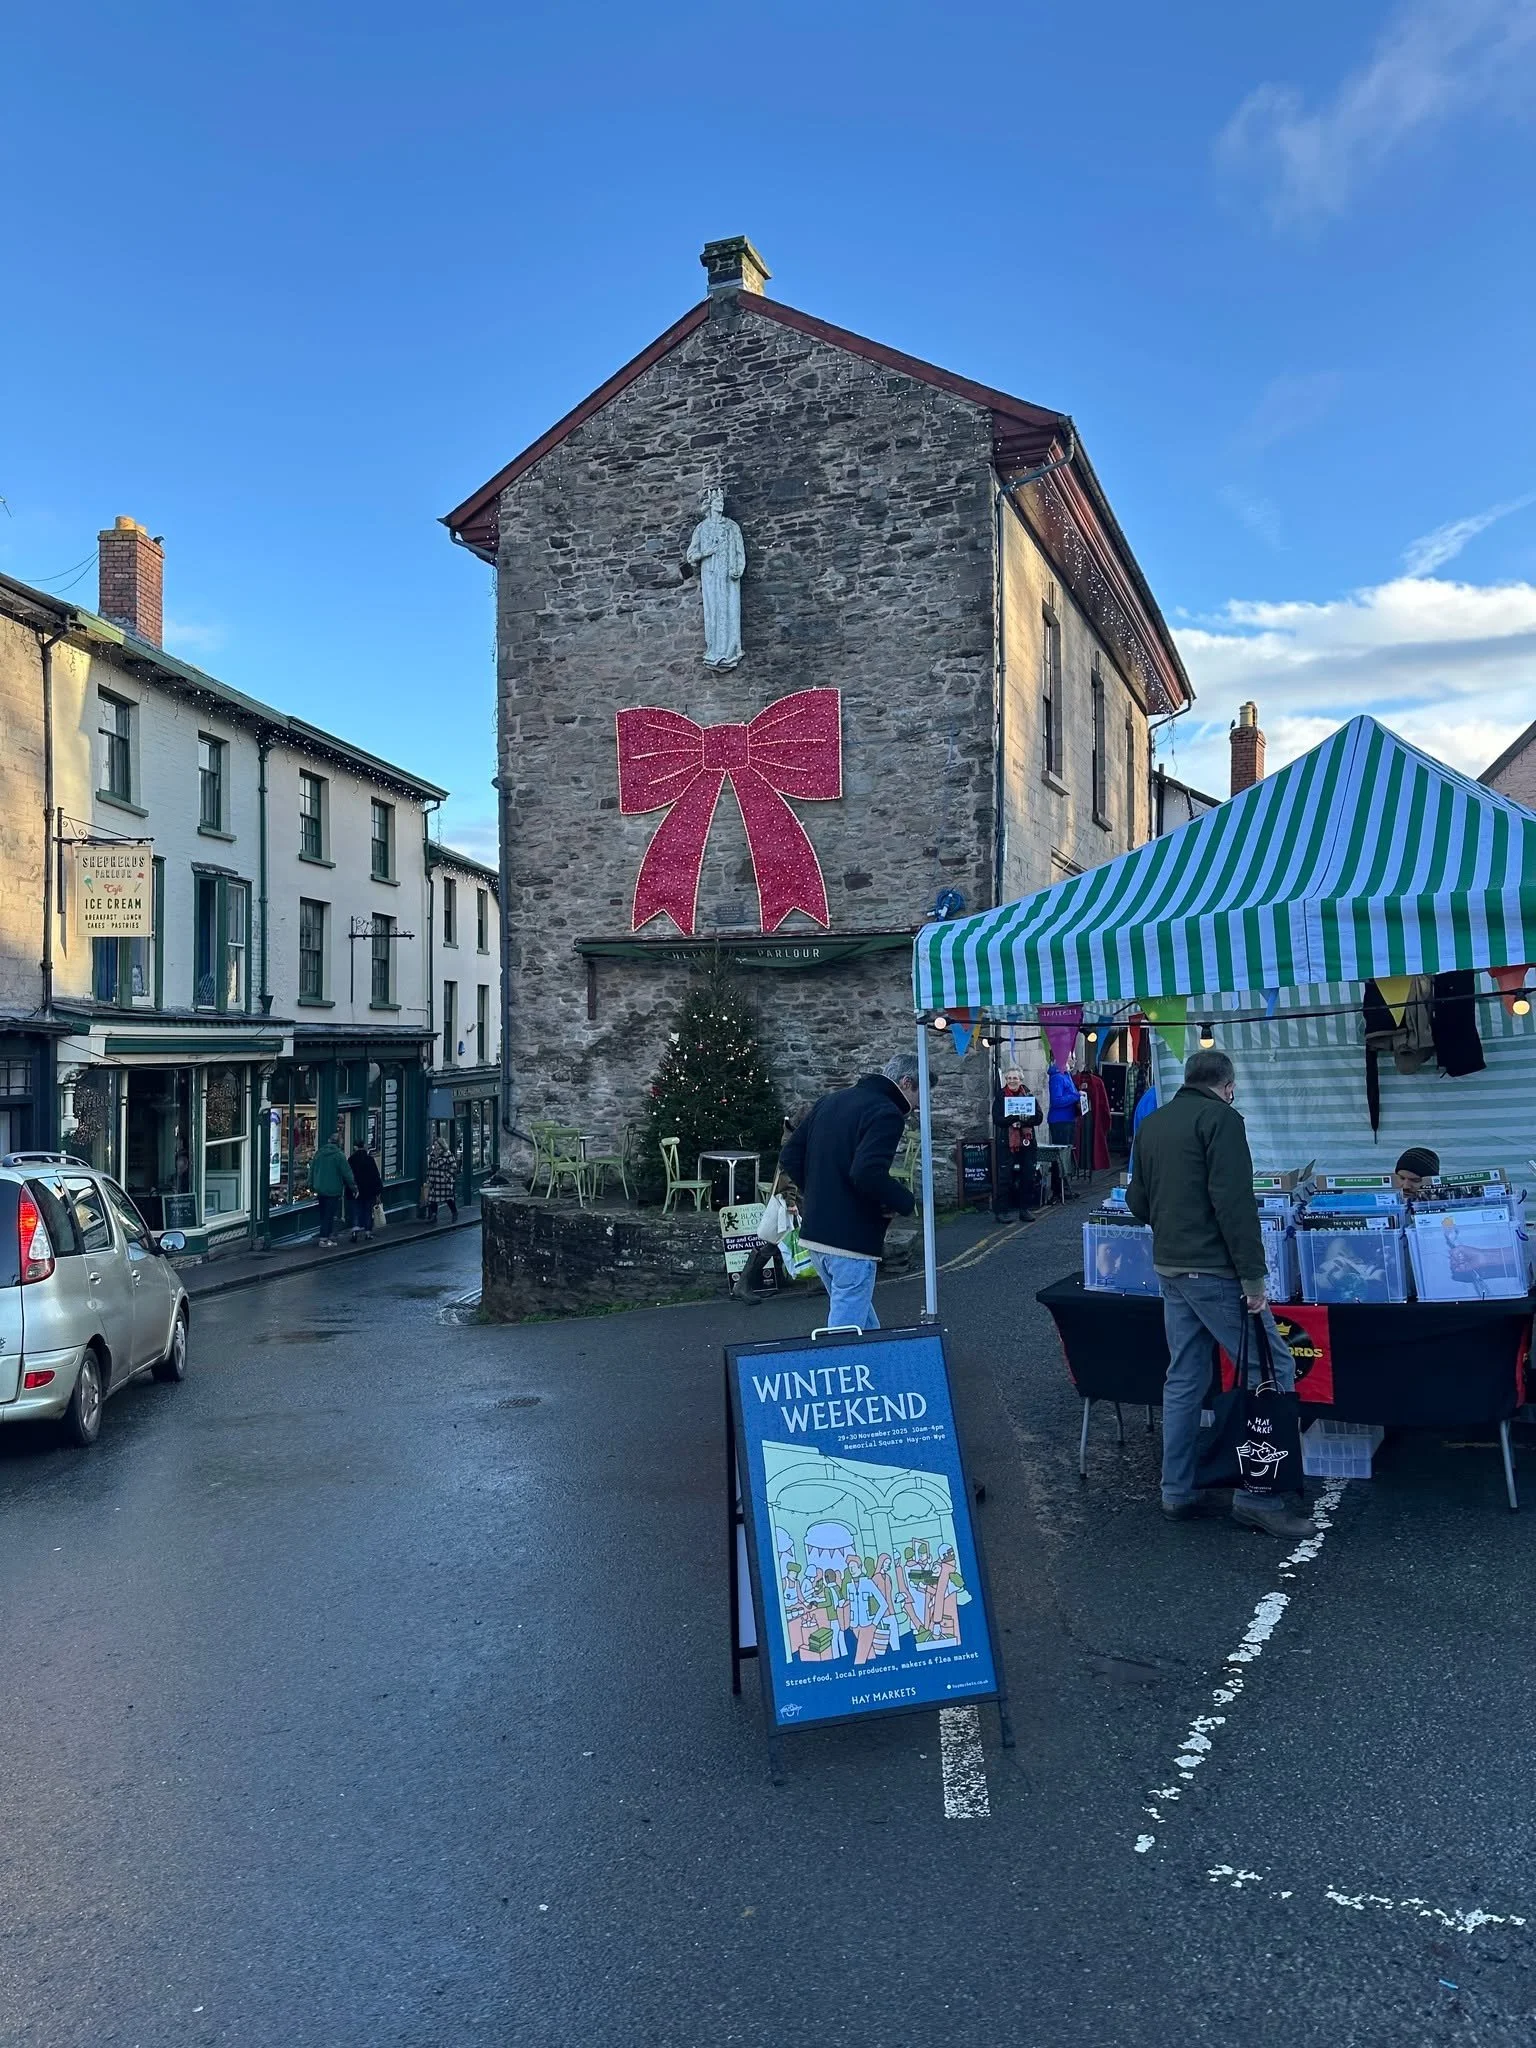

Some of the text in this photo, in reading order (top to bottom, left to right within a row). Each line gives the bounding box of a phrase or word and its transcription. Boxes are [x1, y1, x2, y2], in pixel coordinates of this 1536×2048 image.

[82, 855, 145, 868] SHEPHERDS
[96, 869, 132, 879] PARLOUR
[85, 898, 142, 909] ICE CREAM
[758, 948, 820, 958] PARLOUR
[741, 1218, 762, 1226] LIO
[752, 1364, 875, 1403] WINTER
[781, 1392, 927, 1433] WEEKEND
[1255, 1417, 1270, 1426] HAY
[859, 1430, 891, 1439] November
[844, 1440, 877, 1450] Memorial
[879, 1437, 903, 1446] Square
[785, 1677, 812, 1687] Street
[813, 1673, 832, 1683] food,
[835, 1669, 856, 1679] local
[858, 1665, 898, 1677] producers,
[901, 1660, 927, 1669] makers
[934, 1656, 952, 1664] flea
[953, 1652, 979, 1661] market
[851, 1687, 917, 1705] HAY MARKETS
